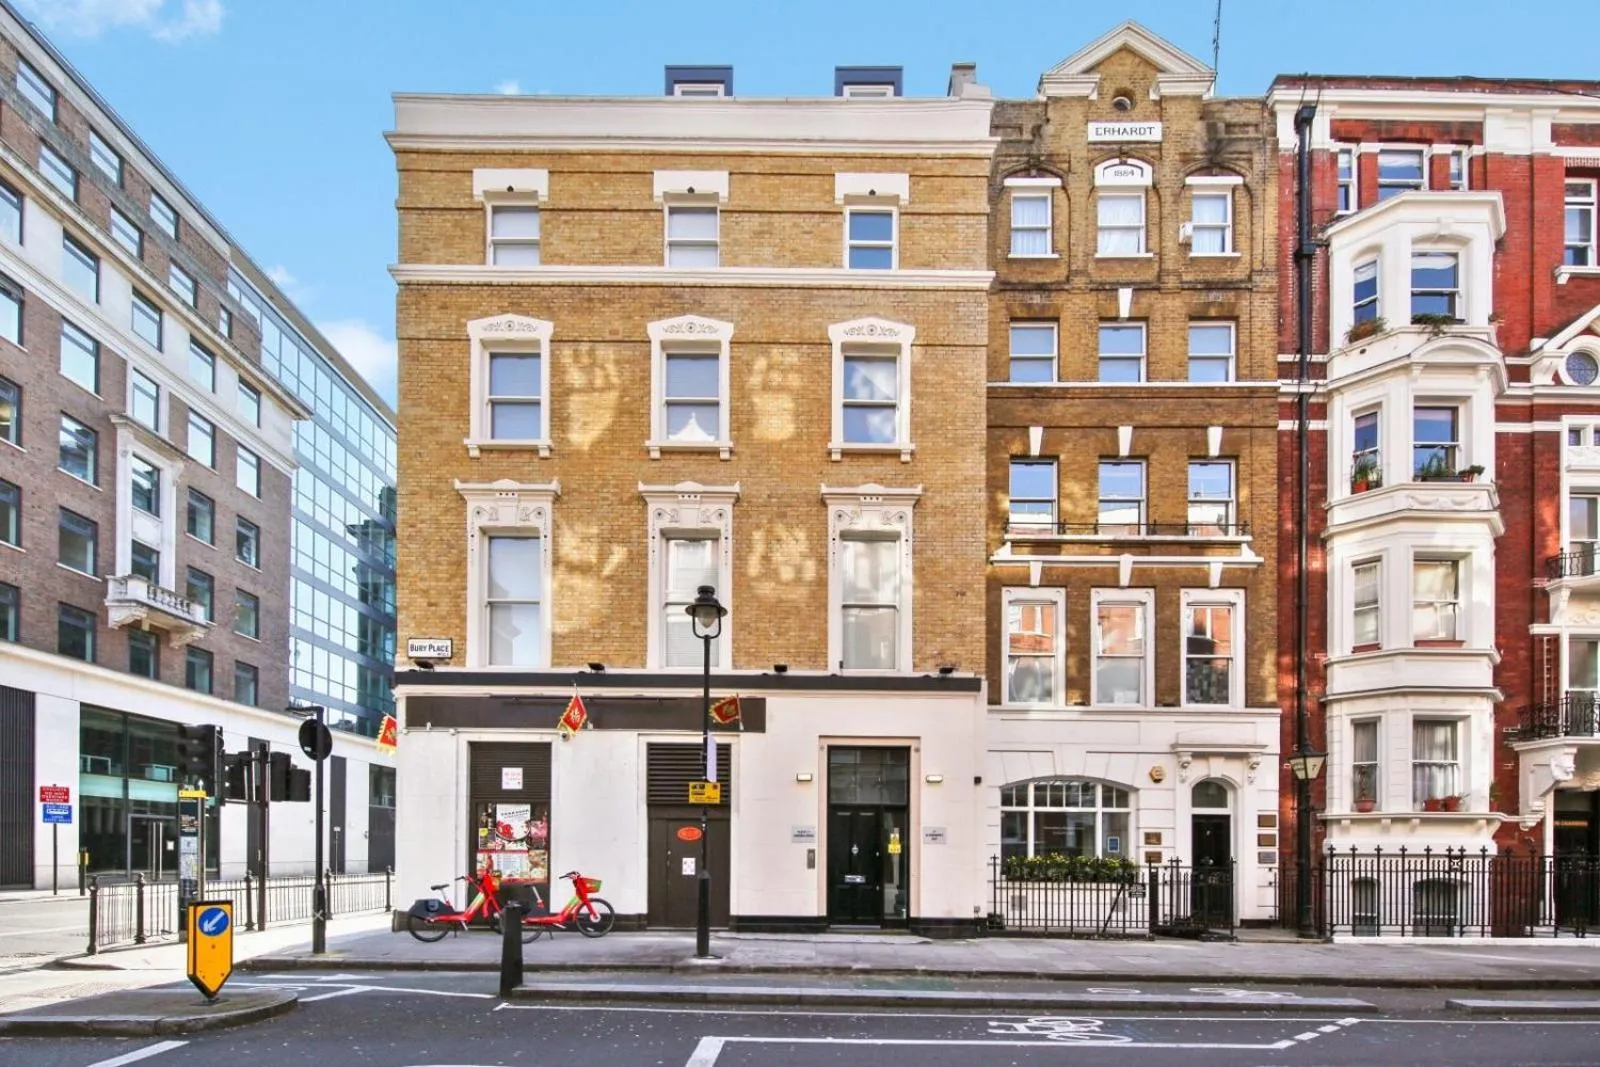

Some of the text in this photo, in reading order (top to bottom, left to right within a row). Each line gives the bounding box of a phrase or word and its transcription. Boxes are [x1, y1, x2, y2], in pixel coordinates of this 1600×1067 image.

[1095, 126, 1155, 136] ERHARDT
[410, 643, 449, 652] BURY PLACE
